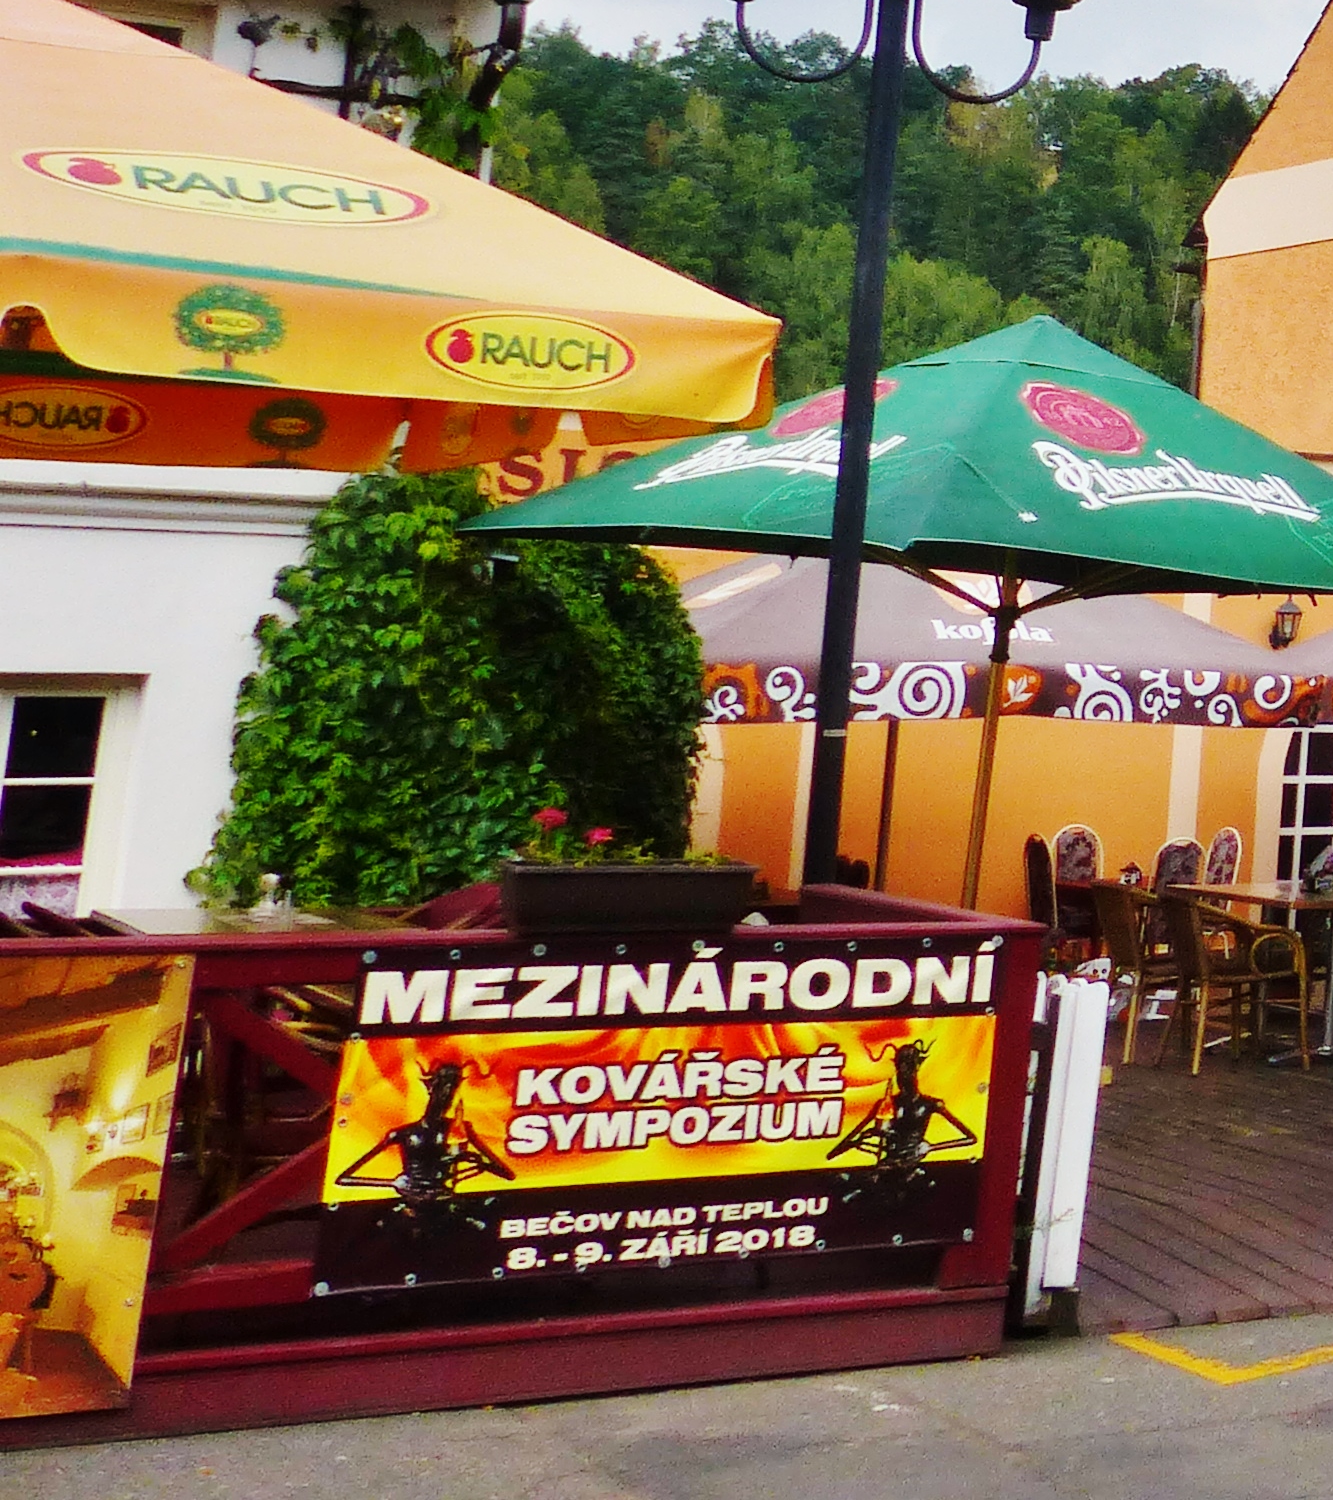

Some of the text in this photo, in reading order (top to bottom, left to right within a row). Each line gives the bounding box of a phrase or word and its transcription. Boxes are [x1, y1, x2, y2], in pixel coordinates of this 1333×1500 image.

[131, 164, 387, 216] RAUCH
[481, 332, 612, 374] RAUCH
[1031, 441, 1321, 518] Pilsner Urquell
[931, 617, 1054, 645] kofla
[359, 942, 998, 1025] MEZINÁRODNÍ
[515, 1046, 847, 1107] KOVÁŘSKÉ
[507, 1100, 843, 1154] SYMPOZIUM
[499, 1197, 830, 1240] BEČOV NAD TEPLOU
[506, 1242, 546, 1271] 8.
[574, 1240, 613, 1267] 9.
[618, 1227, 708, 1260] ZÁŘÍ
[712, 1224, 817, 1253] 2018
